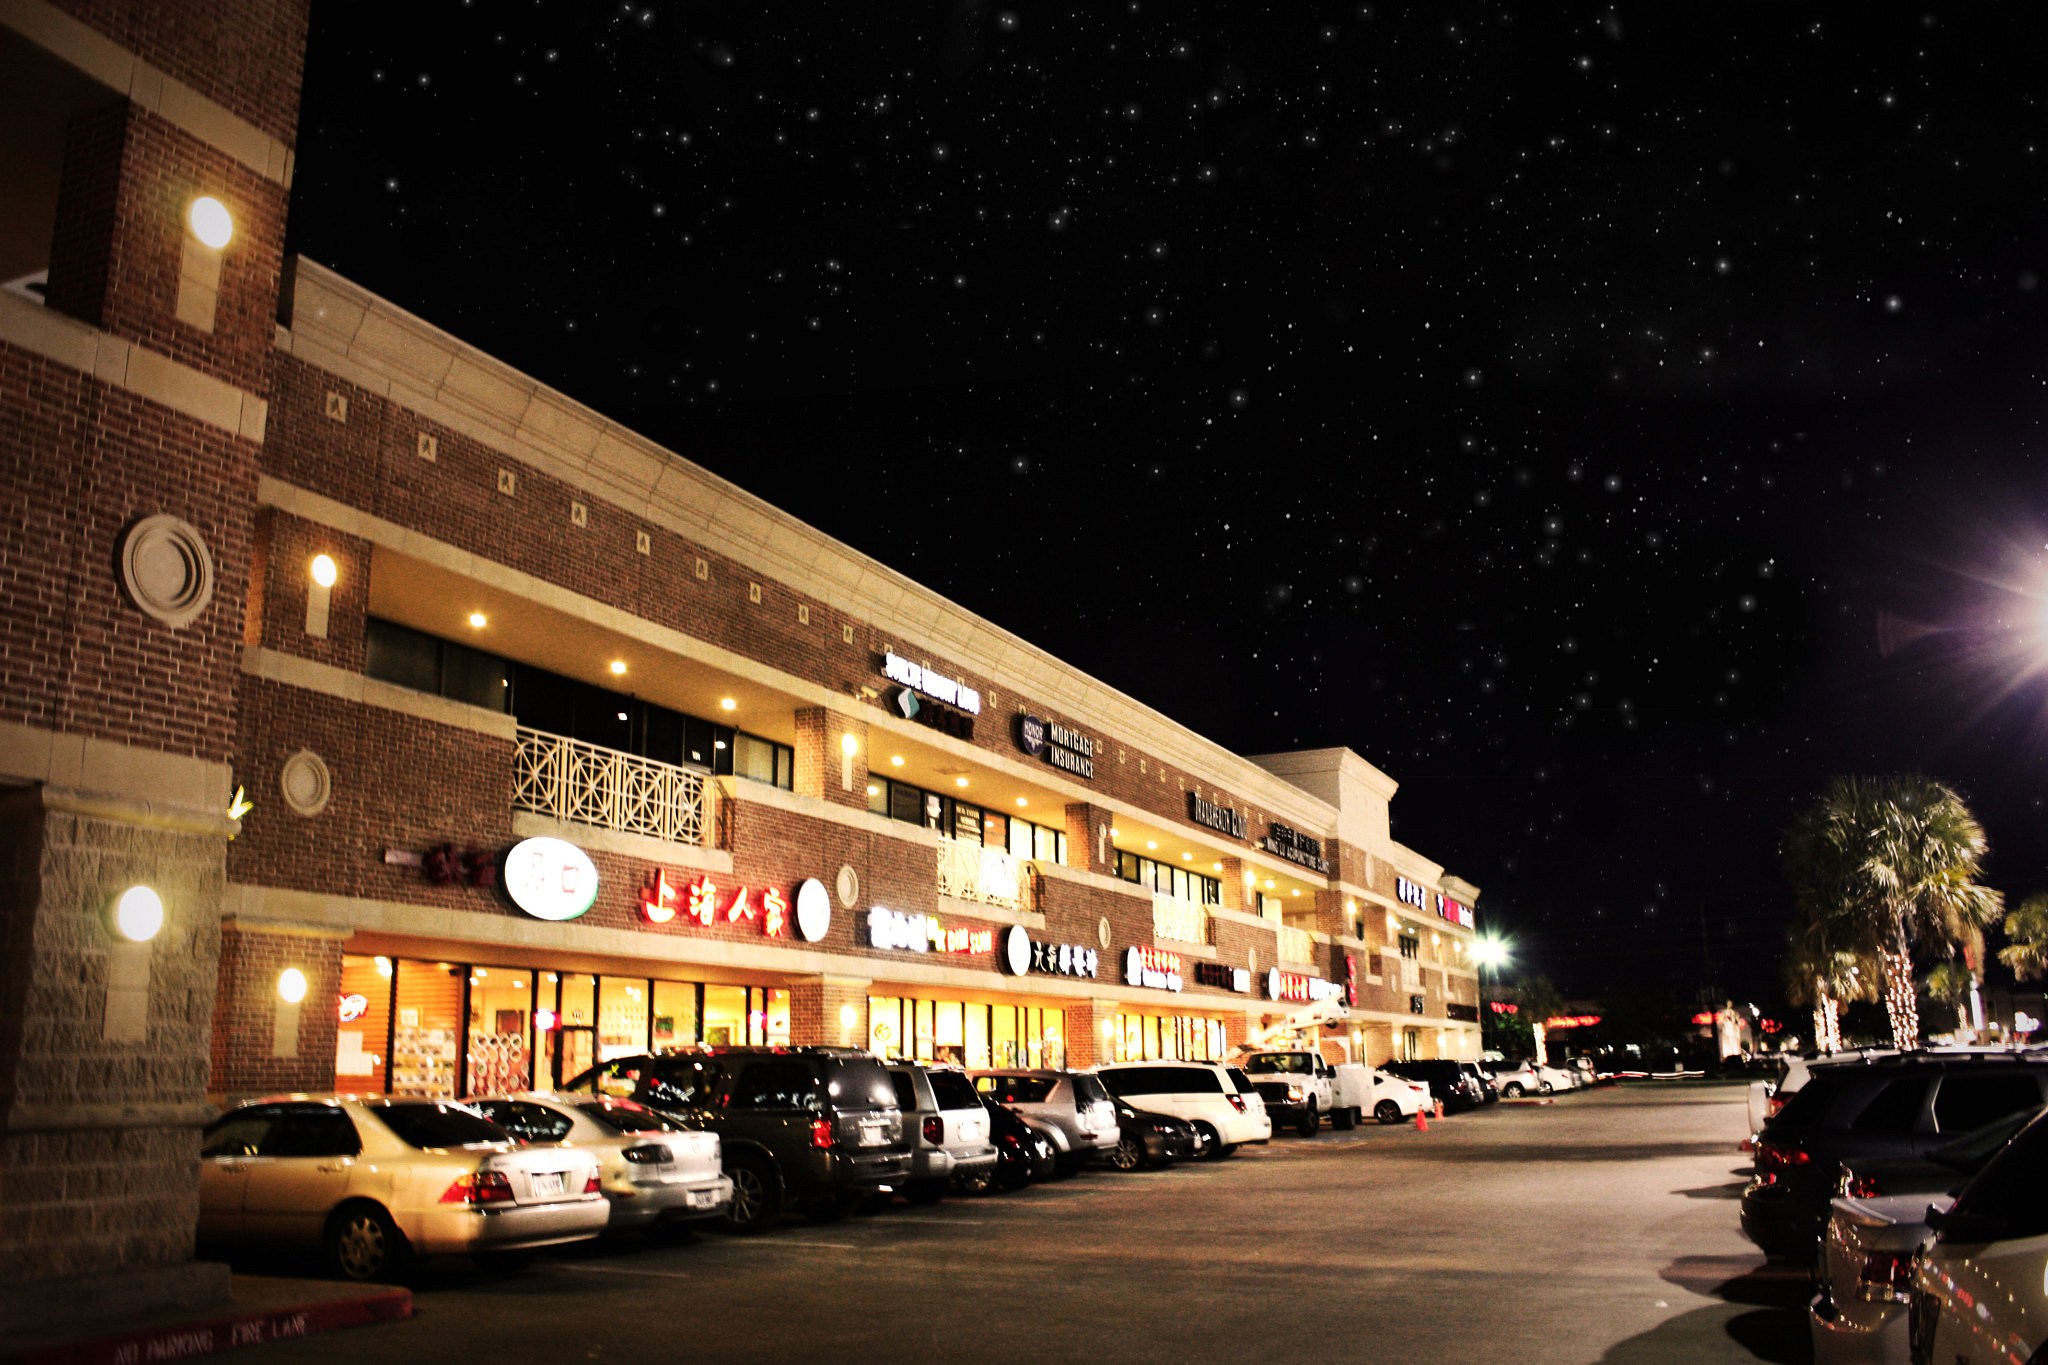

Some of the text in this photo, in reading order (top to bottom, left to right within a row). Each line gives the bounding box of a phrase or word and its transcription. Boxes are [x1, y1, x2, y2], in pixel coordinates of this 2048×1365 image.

[1024, 720, 1044, 741] HONOR
[1051, 719, 1093, 757] MORTGAGE
[1051, 745, 1093, 779] INSURANCE
[643, 866, 788, 939] 上海人家
[947, 927, 969, 953] DIM
[969, 929, 993, 955] SUM
[271, 1311, 309, 1338] LAN
